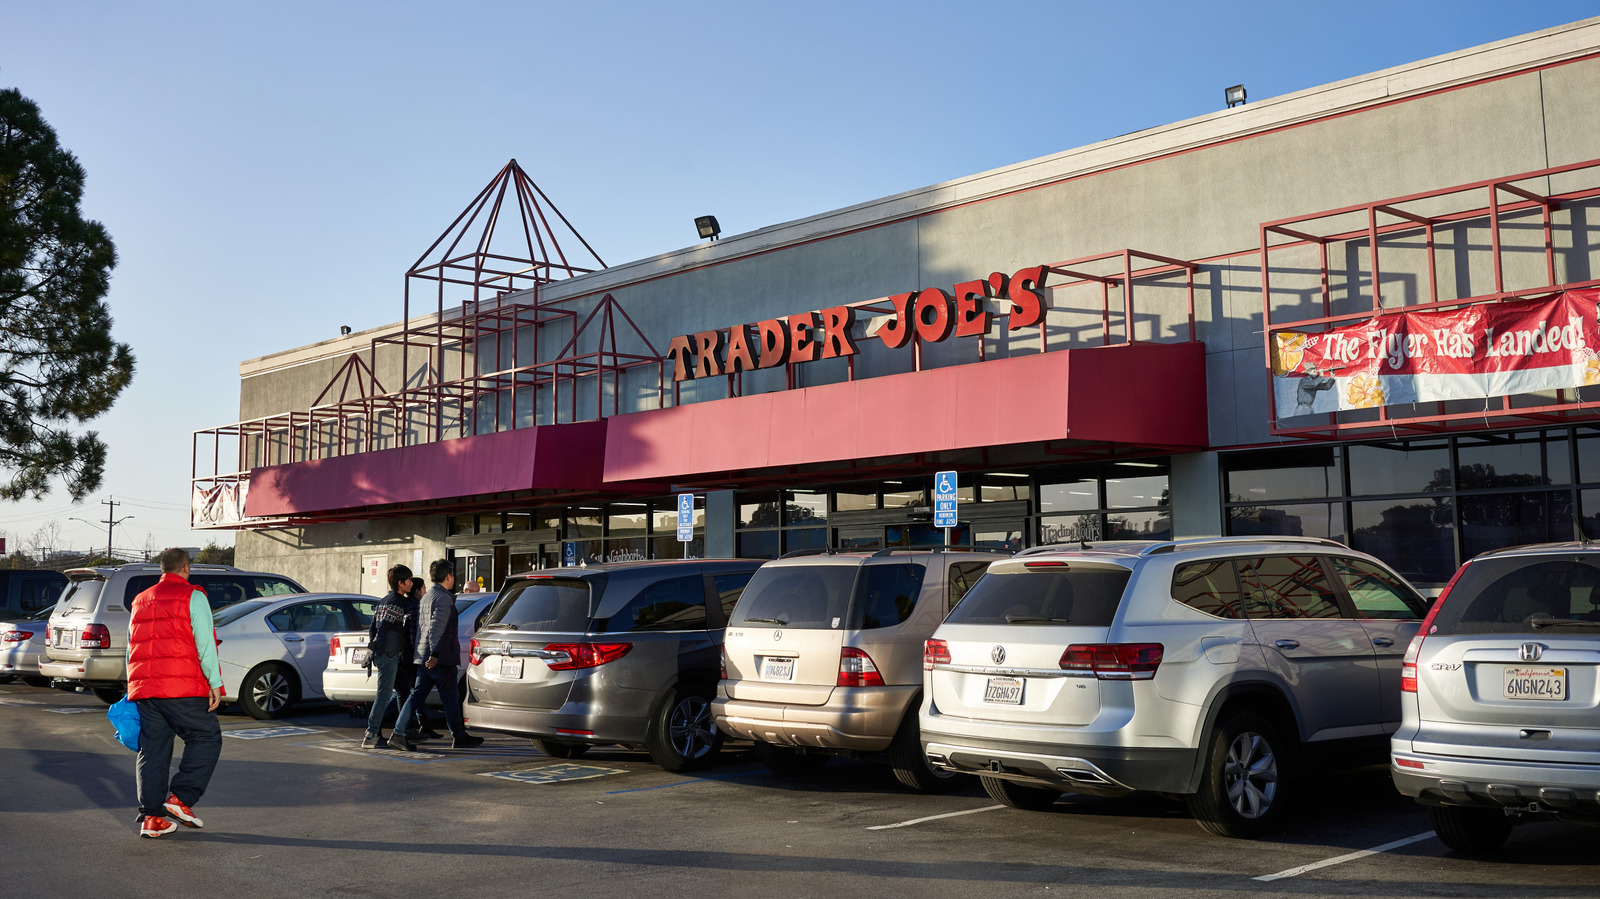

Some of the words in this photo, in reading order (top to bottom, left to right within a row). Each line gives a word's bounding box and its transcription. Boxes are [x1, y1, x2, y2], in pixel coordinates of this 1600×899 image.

[667, 305, 860, 382] TRADER
[875, 265, 1050, 349] JOE'S
[1322, 333, 1360, 364] The
[1367, 328, 1429, 370] Flyer
[1434, 328, 1475, 359] Has
[1484, 316, 1585, 357] Landed!
[936, 492, 956, 502] PARKING
[940, 502, 953, 510] ONLY
[1040, 523, 1075, 545] Trading
[1515, 669, 1554, 678] California
[987, 686, 1020, 700] 7ZGH497
[1507, 678, 1561, 695] 6NGN243
